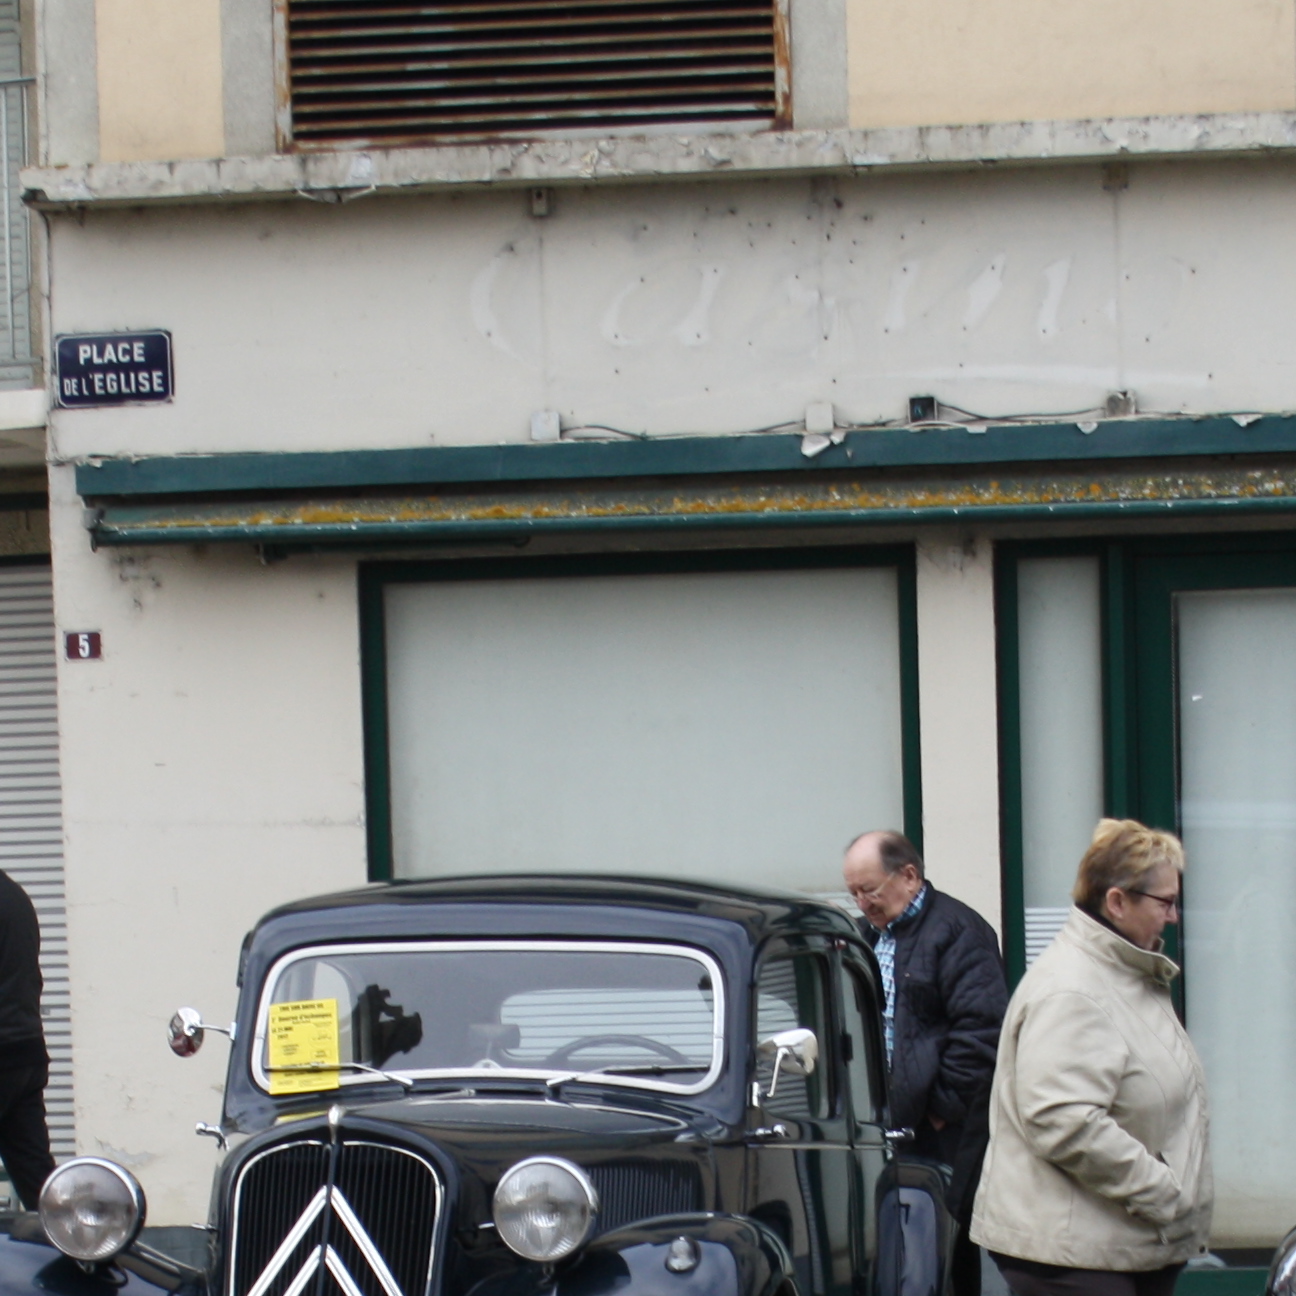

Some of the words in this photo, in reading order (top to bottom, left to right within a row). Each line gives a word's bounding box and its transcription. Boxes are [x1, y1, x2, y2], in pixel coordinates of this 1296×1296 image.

[78, 342, 146, 365] PLACE
[63, 377, 79, 396] DE
[77, 633, 91, 658] 5
